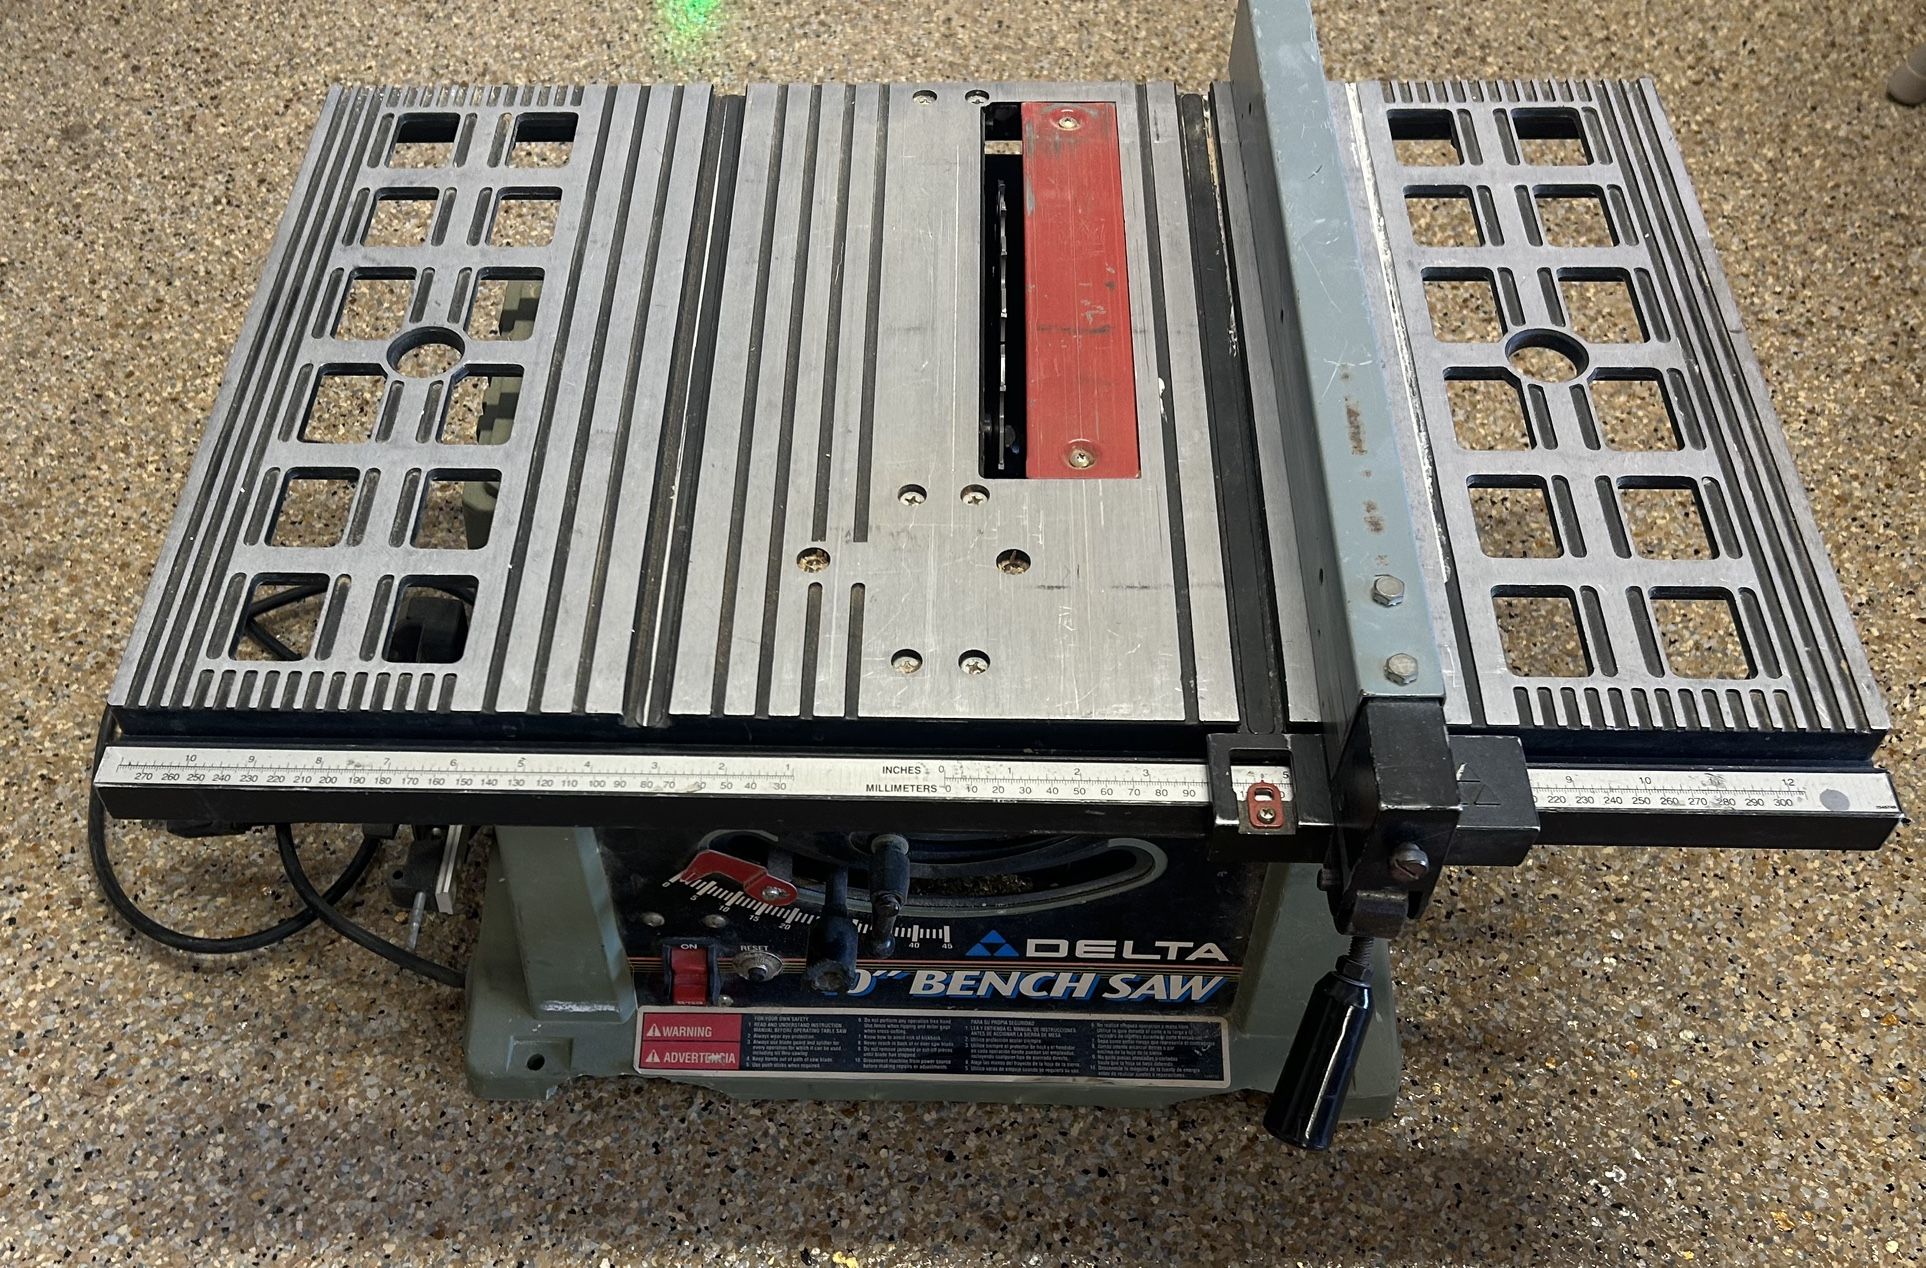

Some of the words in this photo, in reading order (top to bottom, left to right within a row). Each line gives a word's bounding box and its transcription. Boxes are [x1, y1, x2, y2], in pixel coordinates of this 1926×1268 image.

[186, 754, 197, 762] 10
[882, 766, 921, 774] INCHES
[938, 765, 944, 773] 0
[1143, 769, 1150, 777] 3
[1283, 771, 1289, 779] 5
[187, 773, 205, 781] 250
[266, 775, 285, 783] 220
[319, 776, 337, 784] 200
[349, 776, 365, 784] 190
[402, 777, 419, 785] 170
[456, 778, 473, 786] 150
[537, 779, 554, 787] 120
[562, 779, 578, 787] 110
[614, 780, 627, 788] 90
[640, 780, 653, 788] 80
[664, 781, 676, 789] 70
[720, 782, 733, 790] 50
[744, 782, 757, 790] 40
[775, 782, 786, 790] 30
[1639, 777, 1652, 785] 10
[1782, 778, 1795, 786] 12
[866, 784, 937, 793] MILLIMETERS
[945, 785, 952, 793] 0
[966, 785, 978, 793] 10
[992, 786, 1005, 794] 20
[1019, 786, 1032, 794] 30
[1046, 787, 1059, 795] 40
[1073, 787, 1086, 796] 50
[1100, 788, 1113, 796] 60
[1128, 788, 1141, 797] 70
[1155, 788, 1168, 797] 80
[1183, 789, 1196, 798] 90
[1548, 796, 1566, 804] 220
[1576, 796, 1594, 804] 230
[1604, 796, 1623, 805] 240
[1632, 797, 1651, 805] 250
[1660, 797, 1679, 805] 260
[1689, 797, 1707, 806] 270
[1720, 798, 1736, 806] 280
[1745, 798, 1764, 807] 290
[1774, 799, 1793, 807] 300
[719, 905, 730, 913] 10
[749, 914, 760, 922] 15
[1026, 938, 1229, 961] DELTA
[909, 970, 1098, 998] BENCH
[1102, 973, 1223, 1000] SAW
[662, 1026, 712, 1038] WARNING
[664, 1052, 735, 1064] ADVERTENCIA
